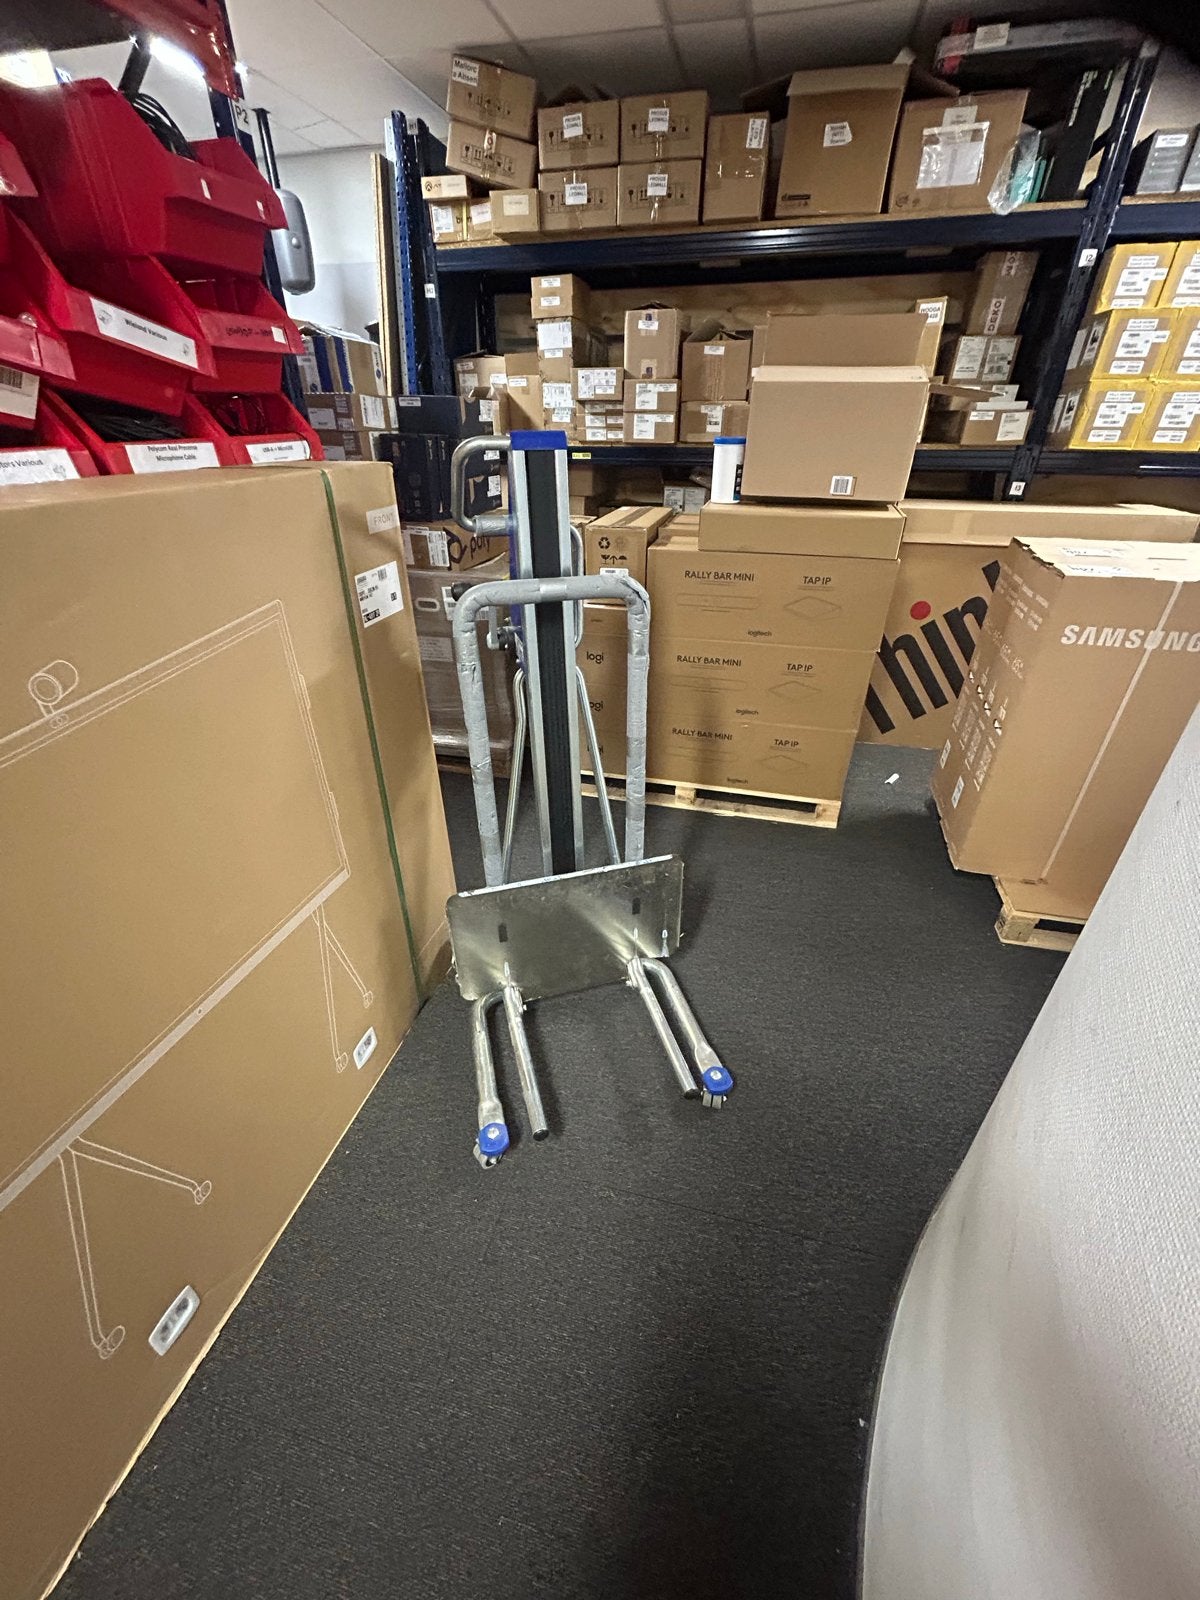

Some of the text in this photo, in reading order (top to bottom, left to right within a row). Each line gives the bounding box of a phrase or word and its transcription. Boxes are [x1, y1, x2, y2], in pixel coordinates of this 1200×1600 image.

[684, 570, 755, 582] RALLY BAR MINI
[803, 575, 832, 585] TAP IP
[1060, 624, 1200, 652] SAMSUNG
[586, 651, 604, 664] logi
[676, 654, 742, 667] RALLY BAR MINI
[786, 663, 813, 672] TAP IP
[671, 727, 733, 741] RALLY BAR MINI
[774, 738, 800, 748] TAP IP
